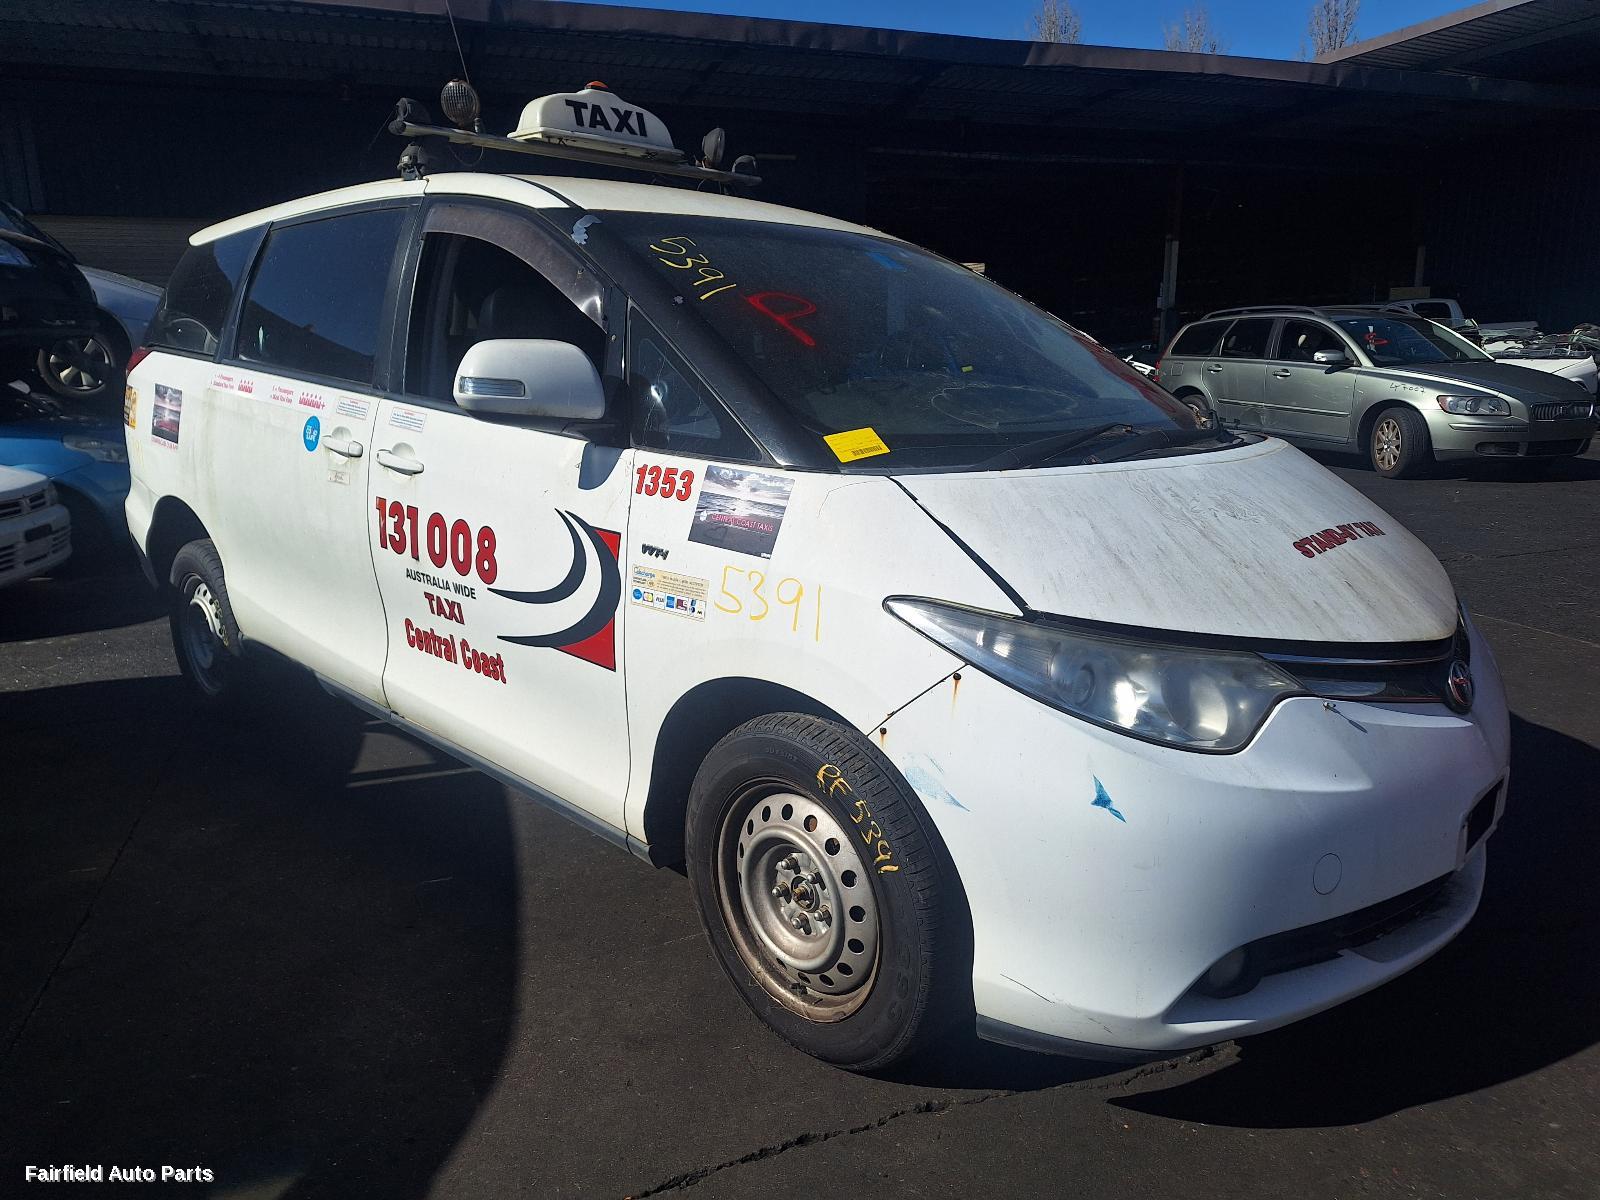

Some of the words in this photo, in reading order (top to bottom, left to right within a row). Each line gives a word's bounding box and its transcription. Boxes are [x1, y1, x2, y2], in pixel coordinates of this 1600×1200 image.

[565, 99, 648, 138] TAXI
[649, 236, 737, 301] 5391
[635, 463, 695, 502] 1353
[375, 496, 420, 561] 131
[427, 512, 498, 585] 008
[711, 513, 735, 525] CENTRAL
[736, 518, 757, 529] COAST
[756, 522, 773, 532] TAXIS
[406, 568, 451, 592] AUSTRALIA
[452, 582, 477, 600] WIDE
[714, 565, 822, 642] 5391
[424, 592, 465, 625] TAXI
[405, 618, 458, 664] Central
[460, 638, 507, 685] Coast
